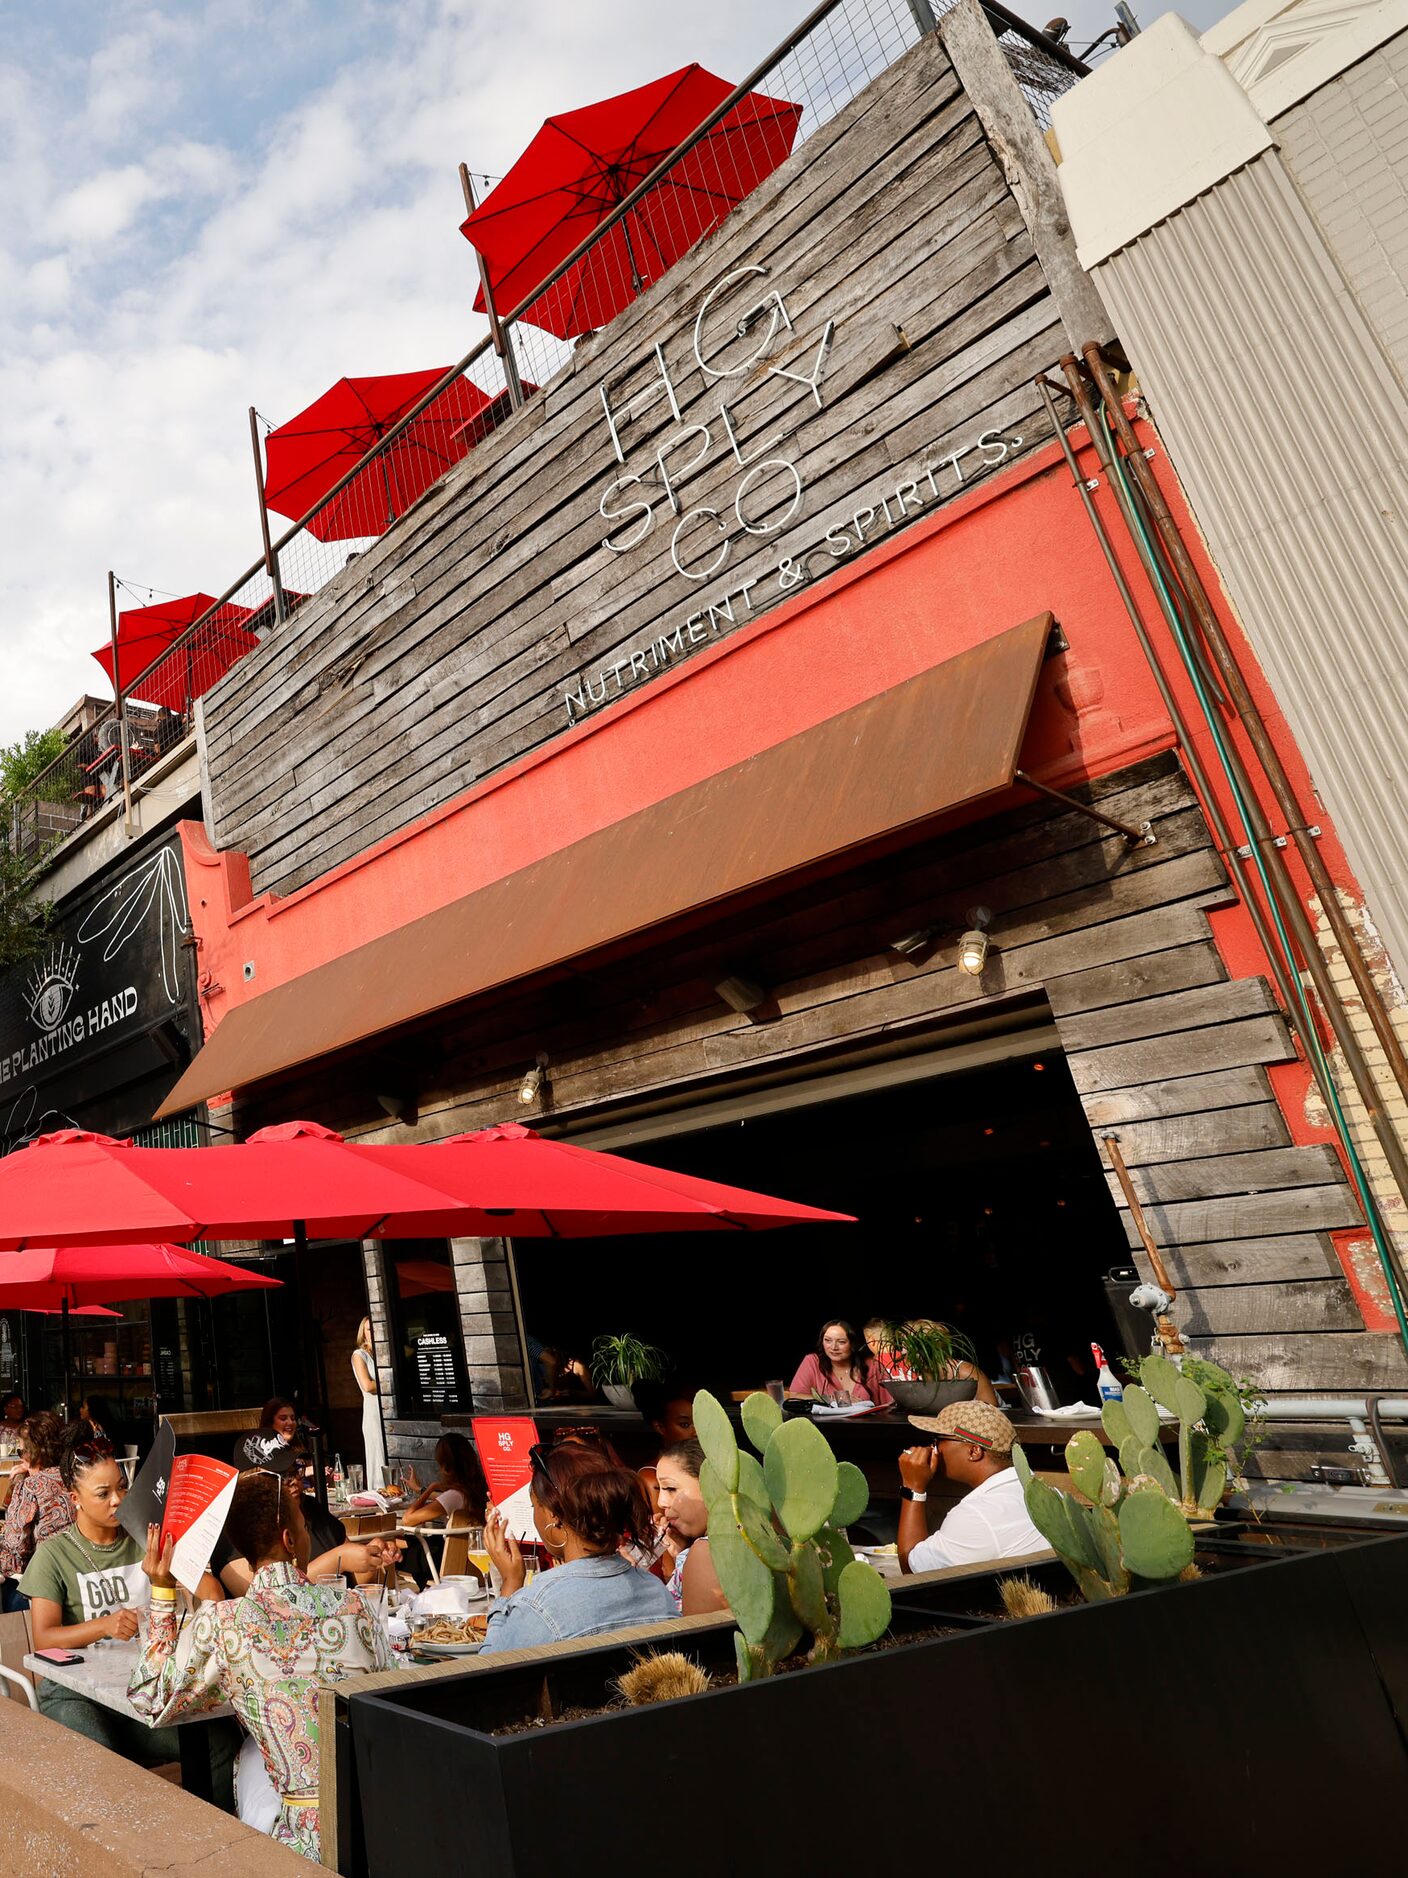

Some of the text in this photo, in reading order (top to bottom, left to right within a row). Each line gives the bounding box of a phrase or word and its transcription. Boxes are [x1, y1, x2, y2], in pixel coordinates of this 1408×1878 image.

[599, 320, 835, 552] SPLY
[671, 459, 802, 579] CO
[564, 579, 757, 726] NUTRIMENT
[778, 557, 804, 590] &
[12, 1015, 85, 1077] PLANTING
[87, 986, 138, 1036] HAND
[417, 1337, 447, 1345] CASHLESS
[497, 1432, 512, 1441] HG
[86, 1575, 130, 1610] GOD
